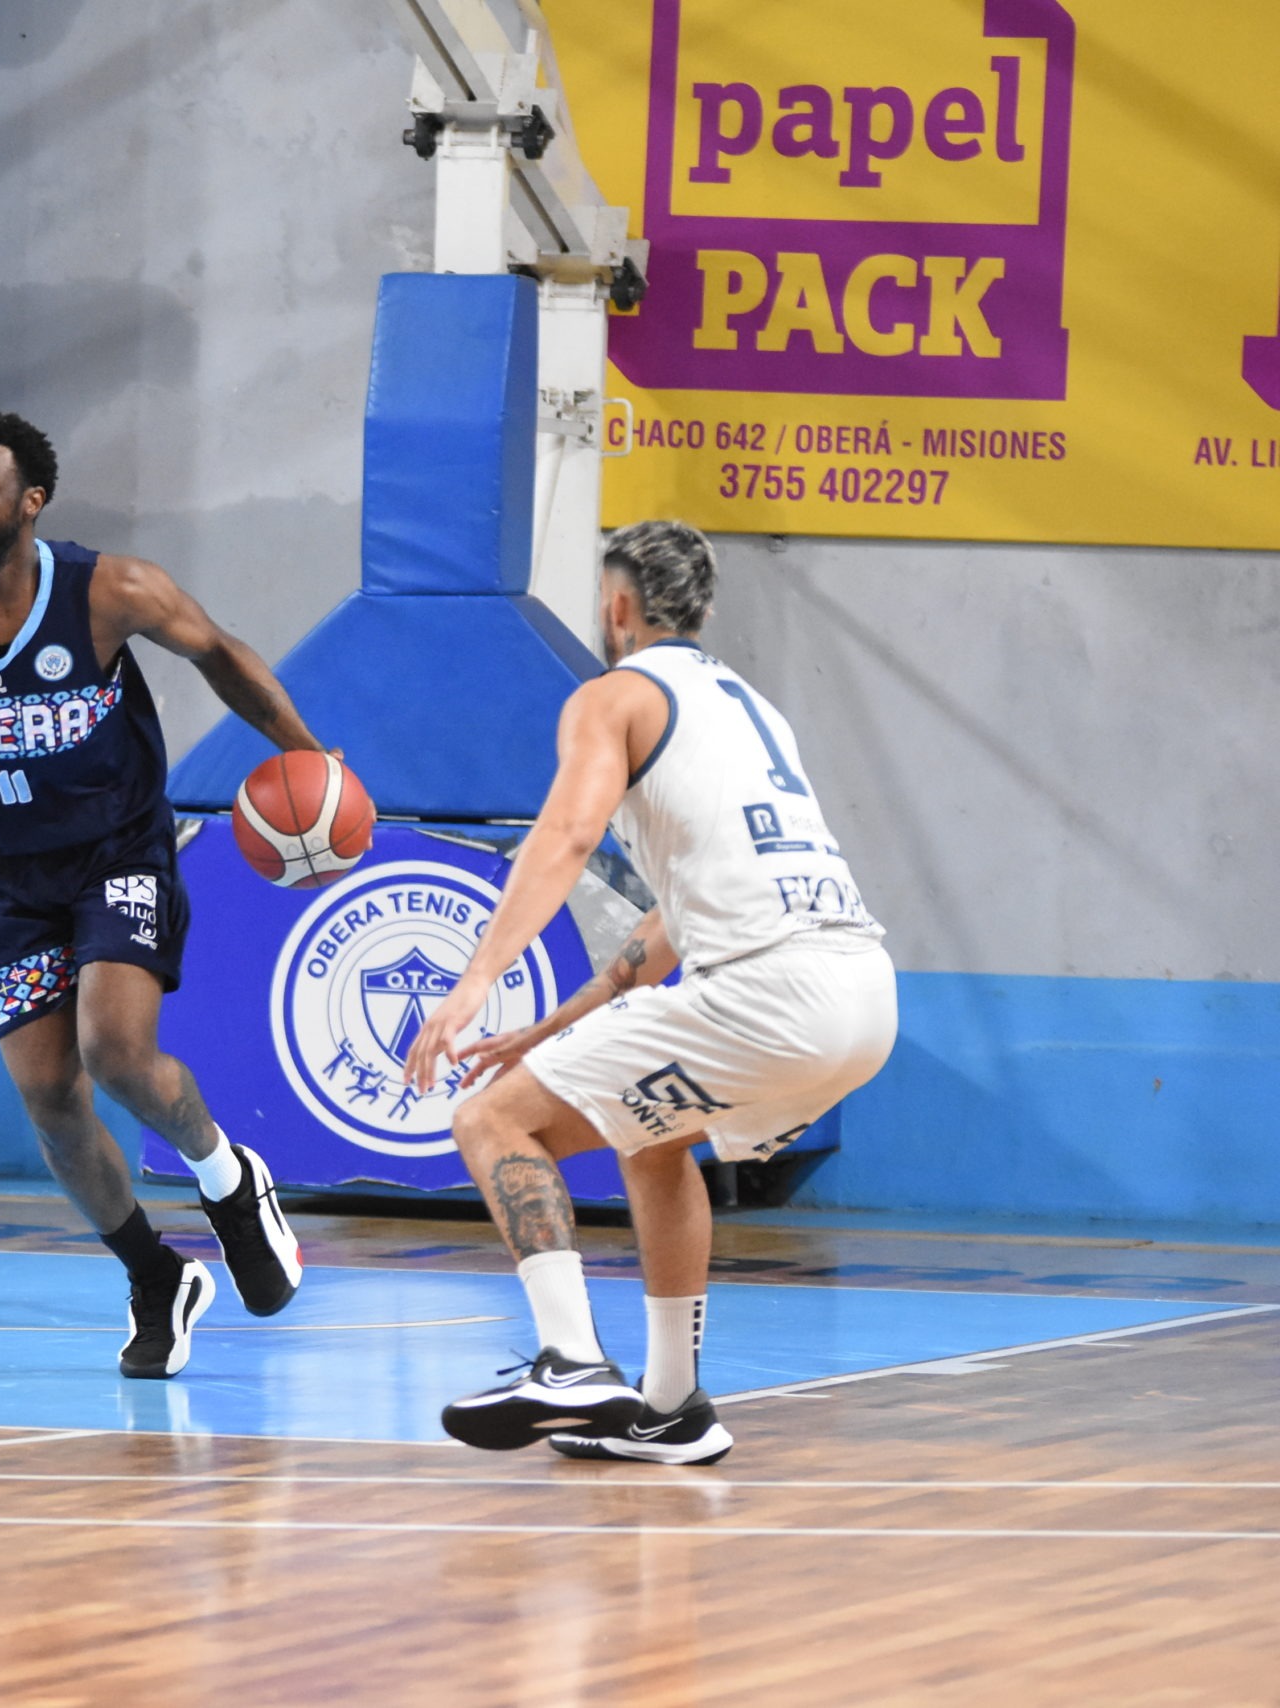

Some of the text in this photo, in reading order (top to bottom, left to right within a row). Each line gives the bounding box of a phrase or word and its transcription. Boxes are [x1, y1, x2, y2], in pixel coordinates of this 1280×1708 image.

[688, 55, 1026, 188] papel
[692, 249, 1006, 358] PACK
[607, 417, 705, 449] CHACO
[715, 421, 766, 451] 642
[795, 419, 892, 455] OBERÁ
[922, 428, 1067, 461] MISIONES
[1194, 436, 1280, 468] AV. LI
[719, 462, 950, 506] 3755 402297
[306, 900, 385, 979] OBERA
[387, 890, 472, 925] TENIS
[385, 970, 448, 991] O.T.C.
